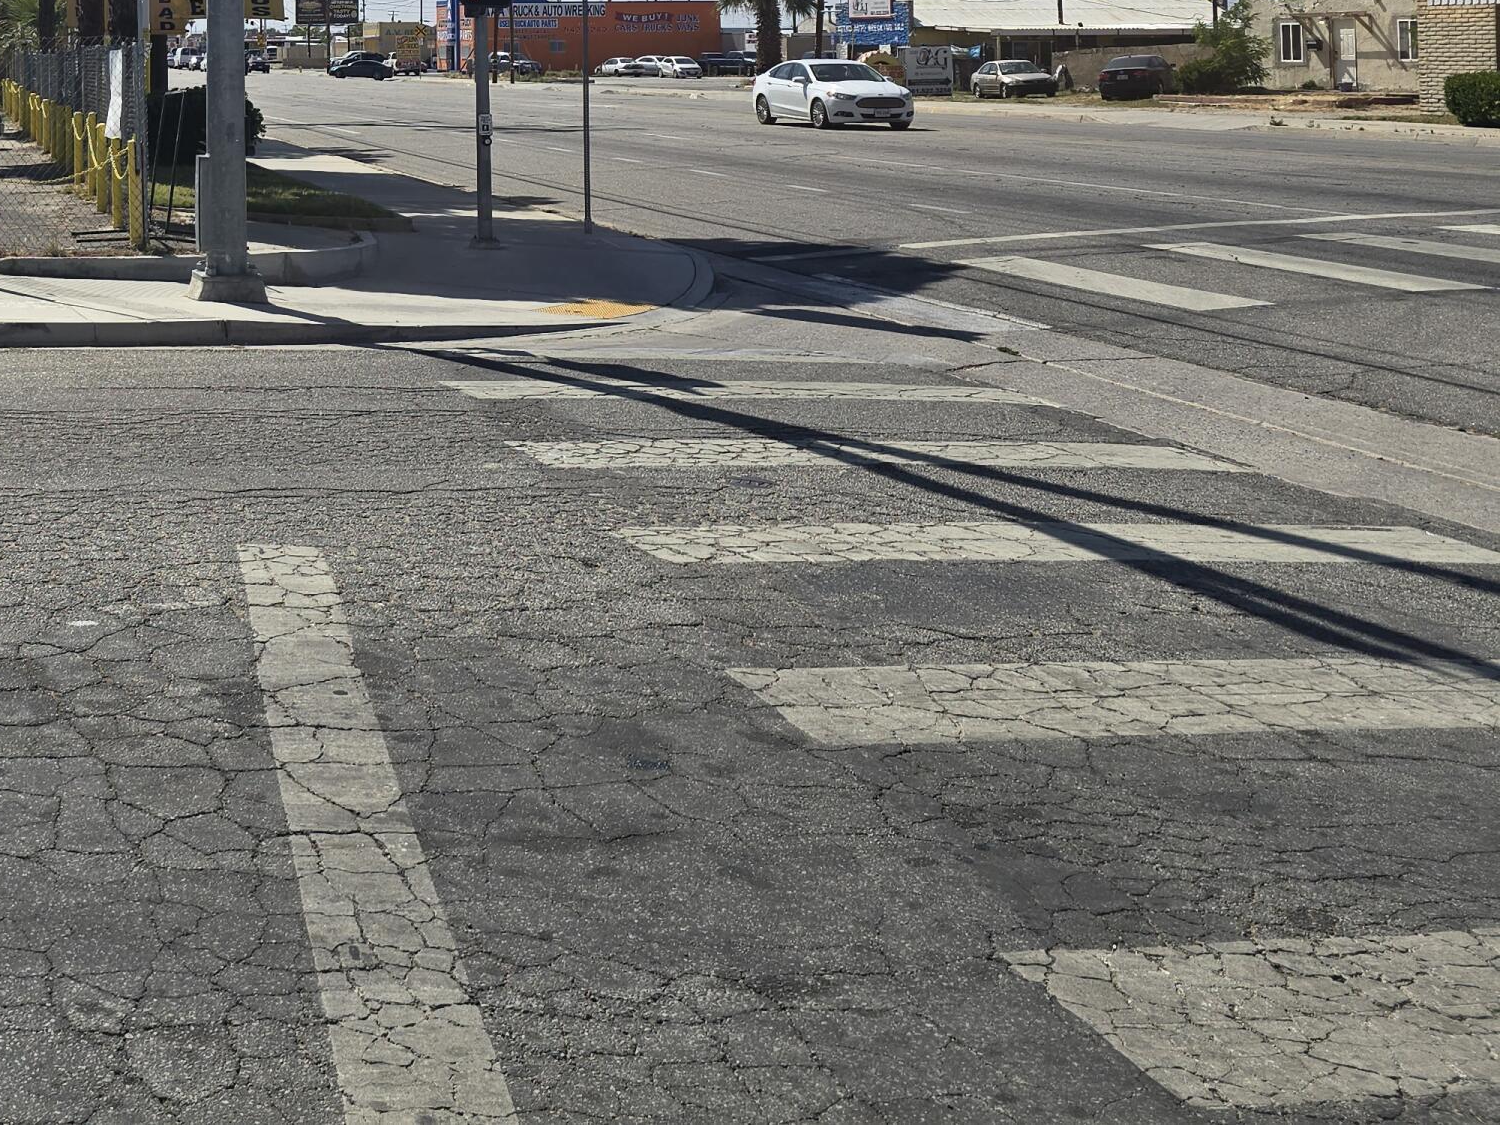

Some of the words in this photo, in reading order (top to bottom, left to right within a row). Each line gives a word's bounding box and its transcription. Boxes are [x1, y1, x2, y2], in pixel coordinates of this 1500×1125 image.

[513, 5, 534, 16] RUCK
[534, 5, 540, 16] &
[543, 5, 563, 16] AUTO
[565, 5, 606, 16] WREKING
[622, 14, 638, 22] WE
[500, 19, 510, 27] USE
[513, 19, 526, 27] RUCK
[541, 19, 557, 27] PARTS
[615, 23, 638, 32] CARS
[676, 23, 700, 32] VANS
